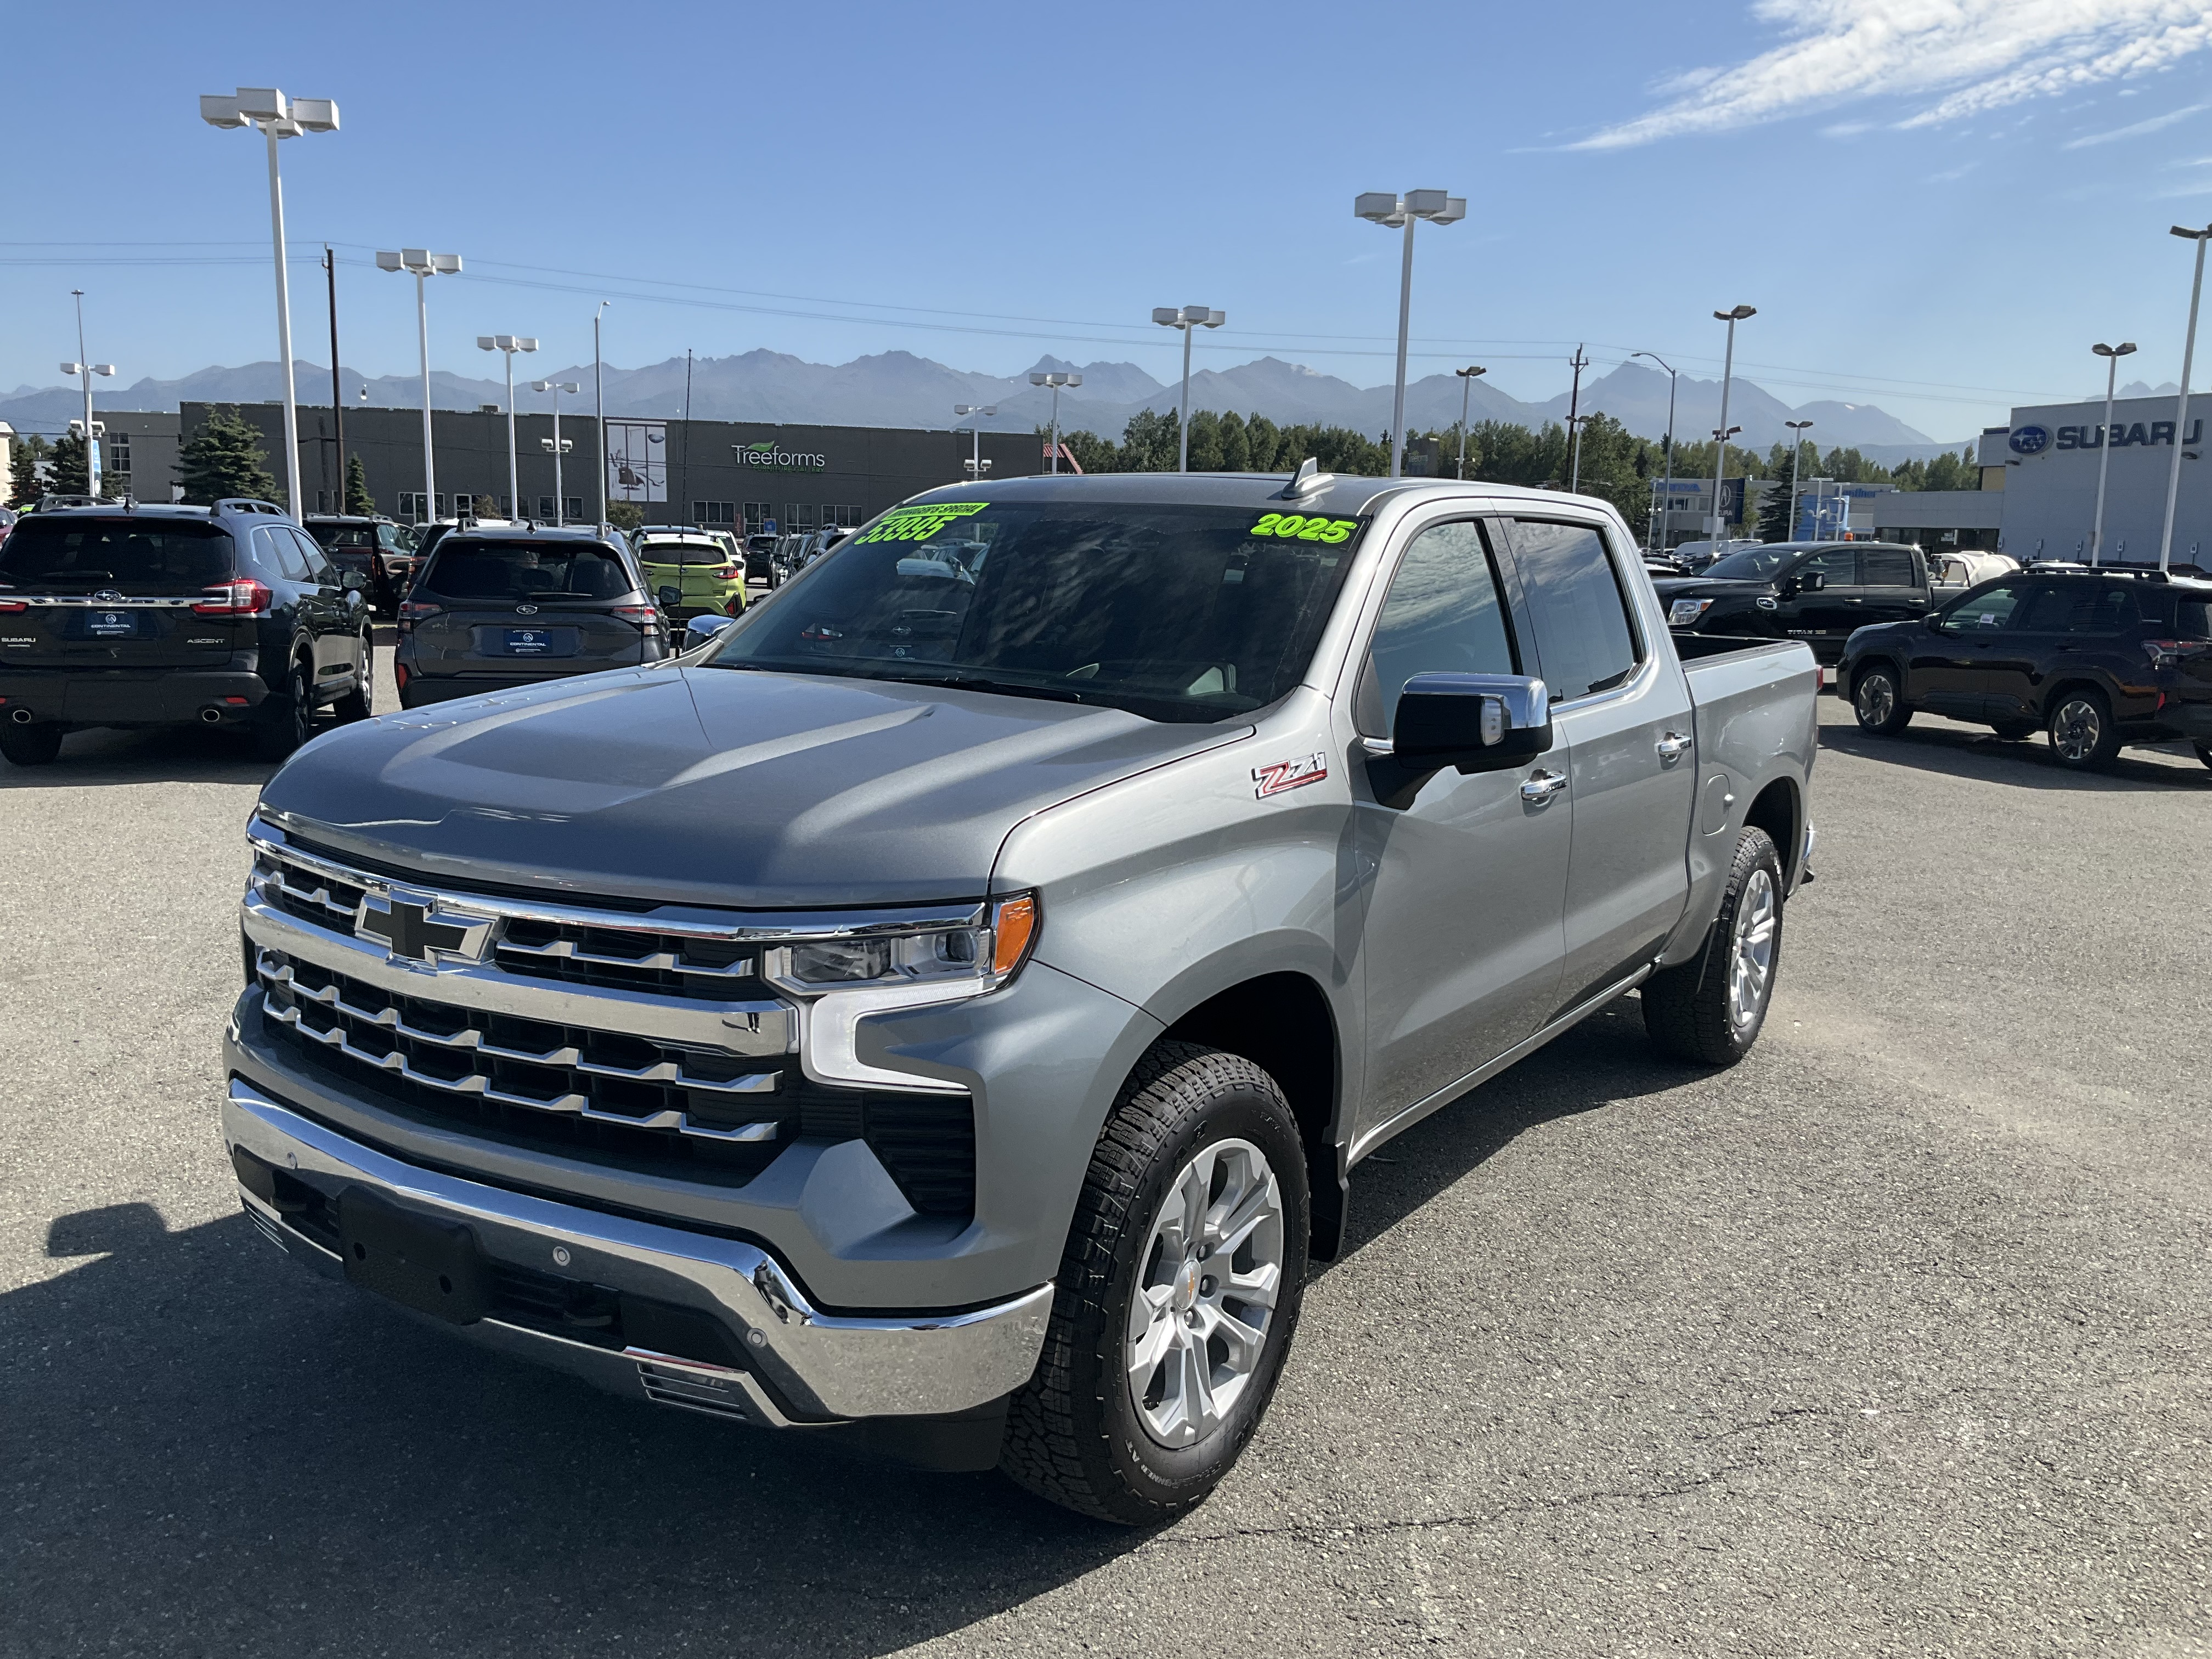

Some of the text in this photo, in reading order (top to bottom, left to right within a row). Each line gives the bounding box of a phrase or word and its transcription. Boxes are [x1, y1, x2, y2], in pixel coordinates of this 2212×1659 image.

[2056, 419, 2202, 449] SUBARU
[731, 445, 825, 466] Treeforms
[854, 516, 957, 545] 53995
[1250, 514, 1357, 544] 2025
[1251, 751, 1328, 800] Z71
